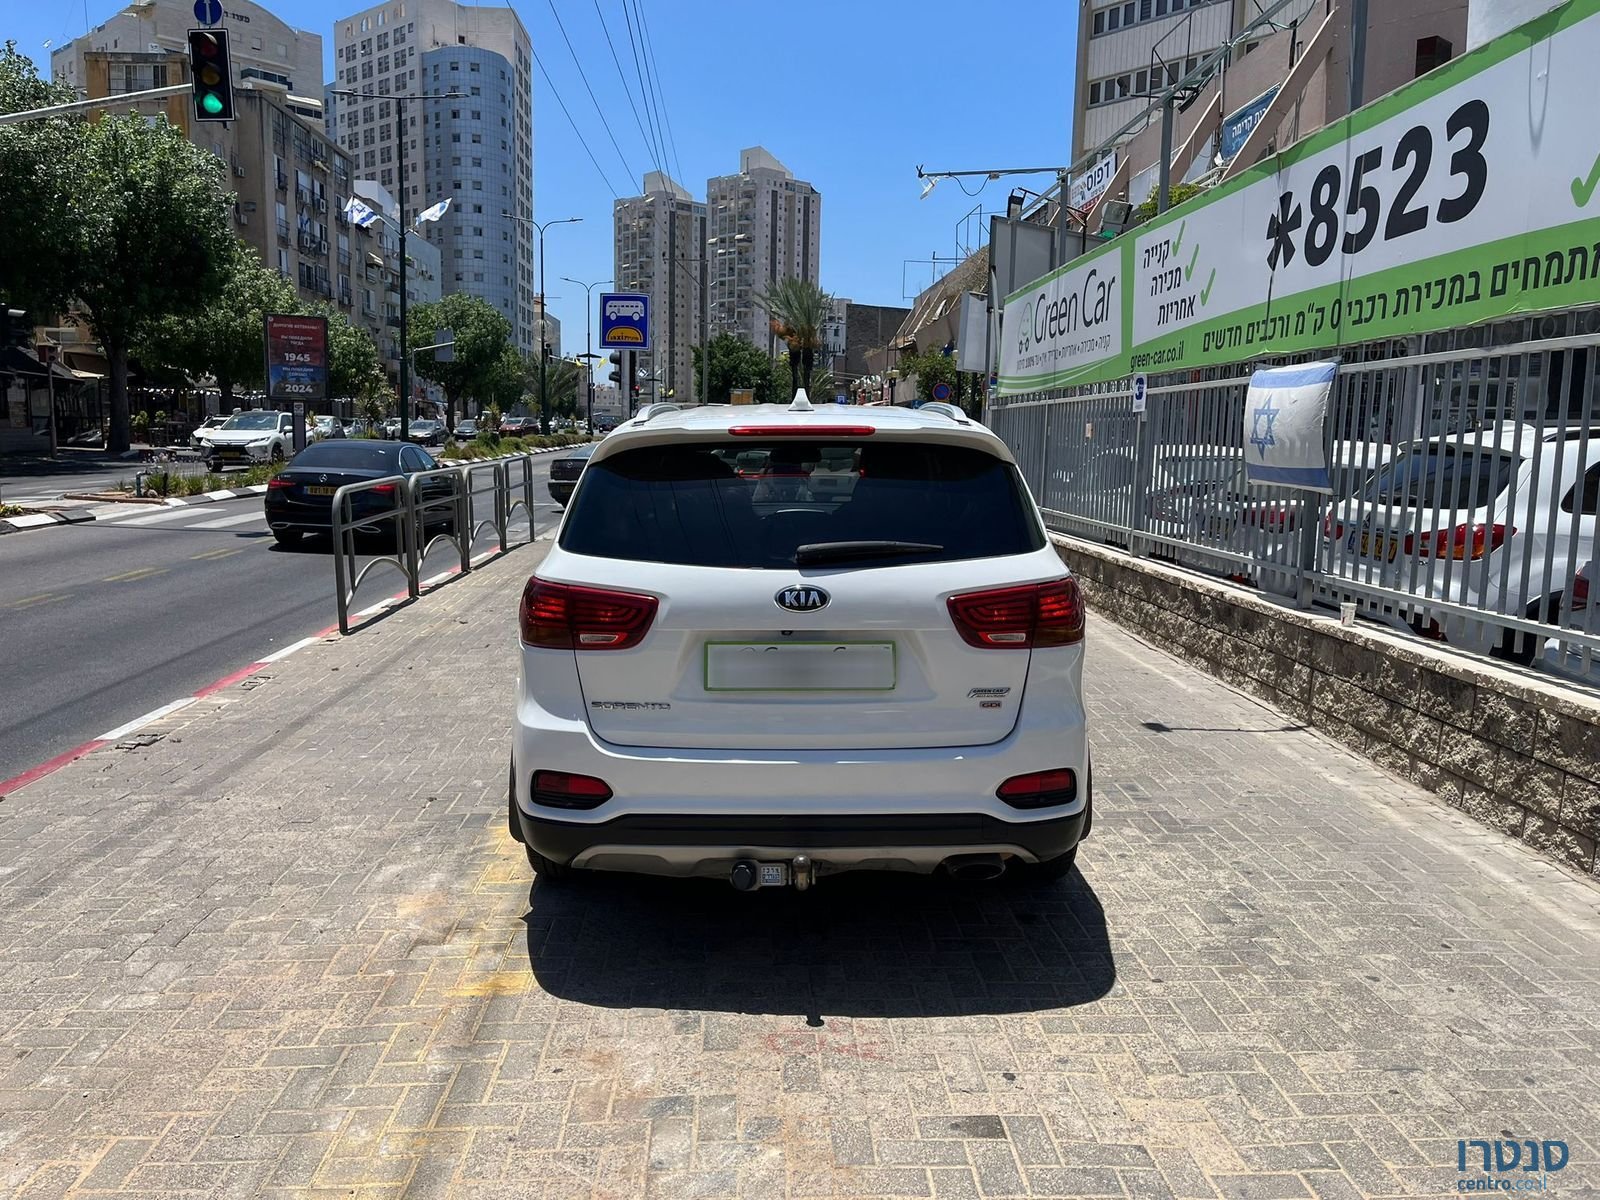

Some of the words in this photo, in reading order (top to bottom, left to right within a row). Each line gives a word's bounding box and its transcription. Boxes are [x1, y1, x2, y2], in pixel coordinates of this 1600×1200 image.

[1087, 161, 1110, 191] דפוס
[1143, 239, 1170, 269] קנייה
[1150, 266, 1182, 297] מכירה
[1392, 270, 1481, 318] במכירת
[1034, 293, 1078, 344] Green
[1082, 269, 1116, 328] Car
[1157, 294, 1197, 326] אחריות
[1330, 298, 1342, 330] 0
[1347, 292, 1387, 326] רכבי
[1202, 325, 1242, 353] חדשים
[1245, 314, 1290, 345] ורכבים
[284, 352, 311, 362] 1945
[1130, 340, 1185, 373] green-car.co.il
[285, 384, 313, 393] 2024
[784, 590, 822, 607] KIA
[591, 701, 672, 711] SORENTO
